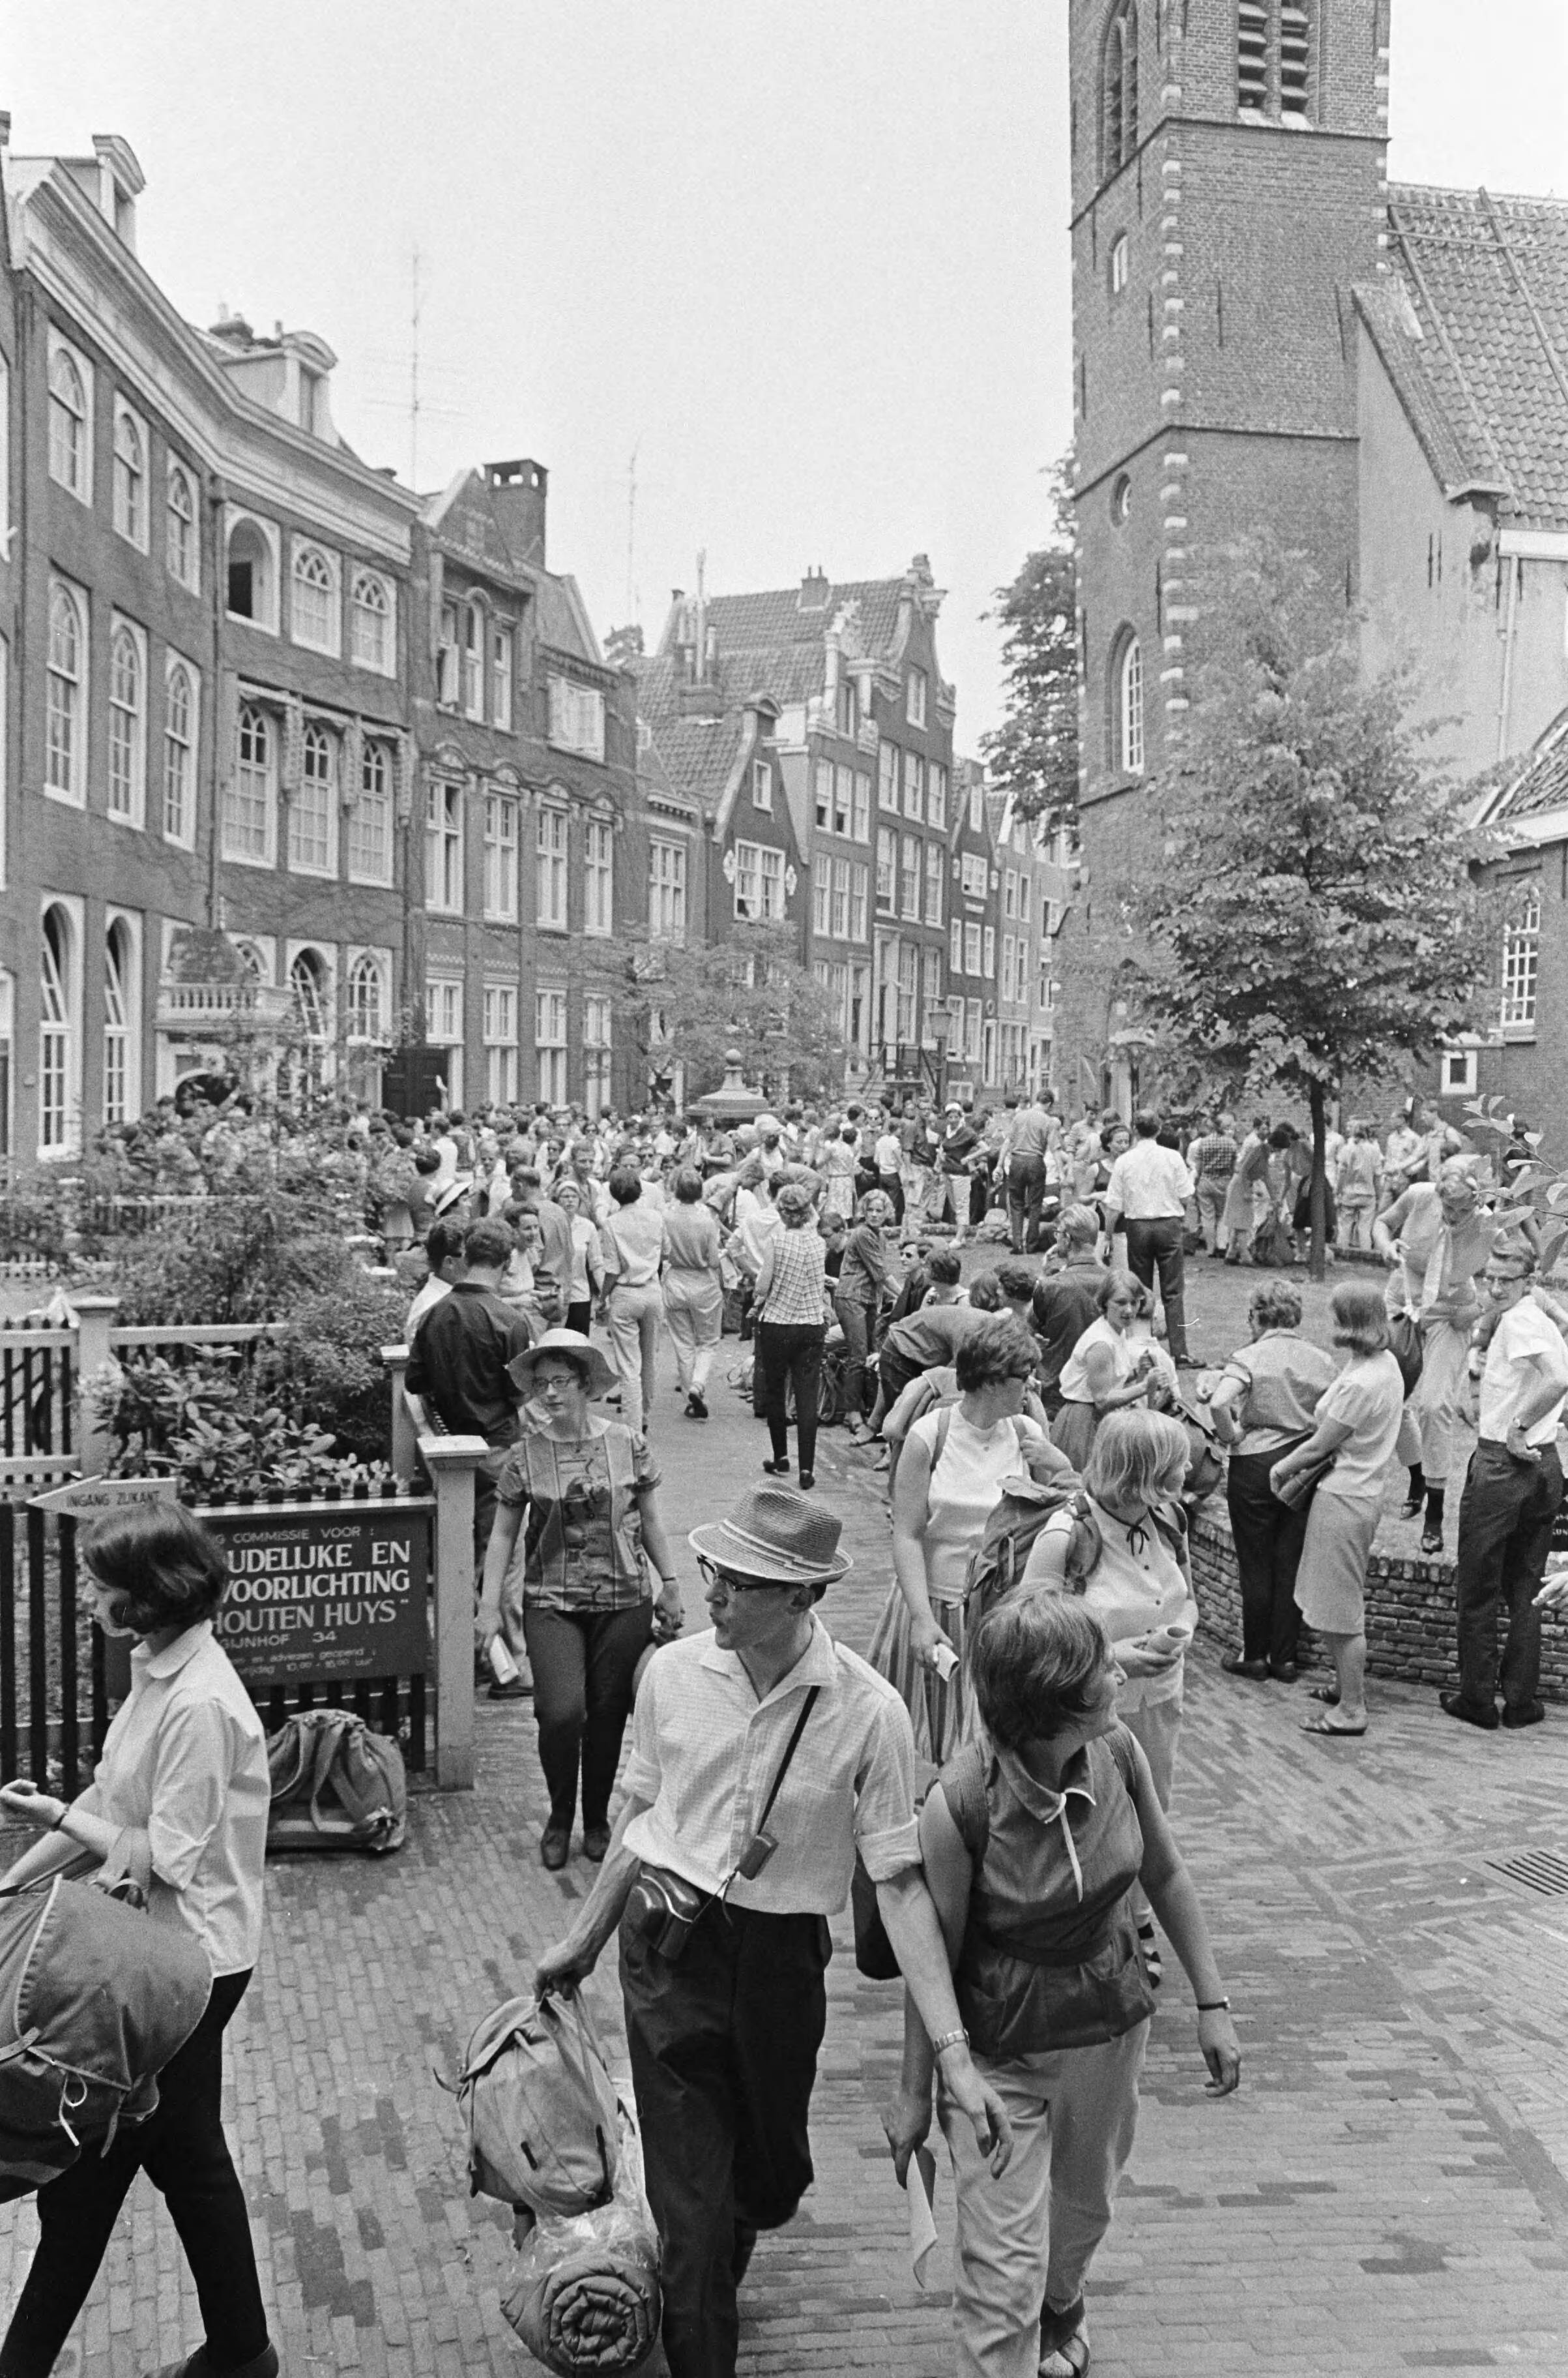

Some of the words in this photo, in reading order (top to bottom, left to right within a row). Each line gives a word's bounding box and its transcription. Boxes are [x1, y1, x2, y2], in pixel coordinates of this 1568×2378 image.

[232, 1529, 310, 1544] COMMISSIE
[320, 1525, 361, 1538] VOOR
[227, 1543, 353, 1574] UDELIJKE
[371, 1540, 411, 1565] EN
[219, 1633, 291, 1650] GIJNHOF
[312, 1630, 338, 1643] 34
